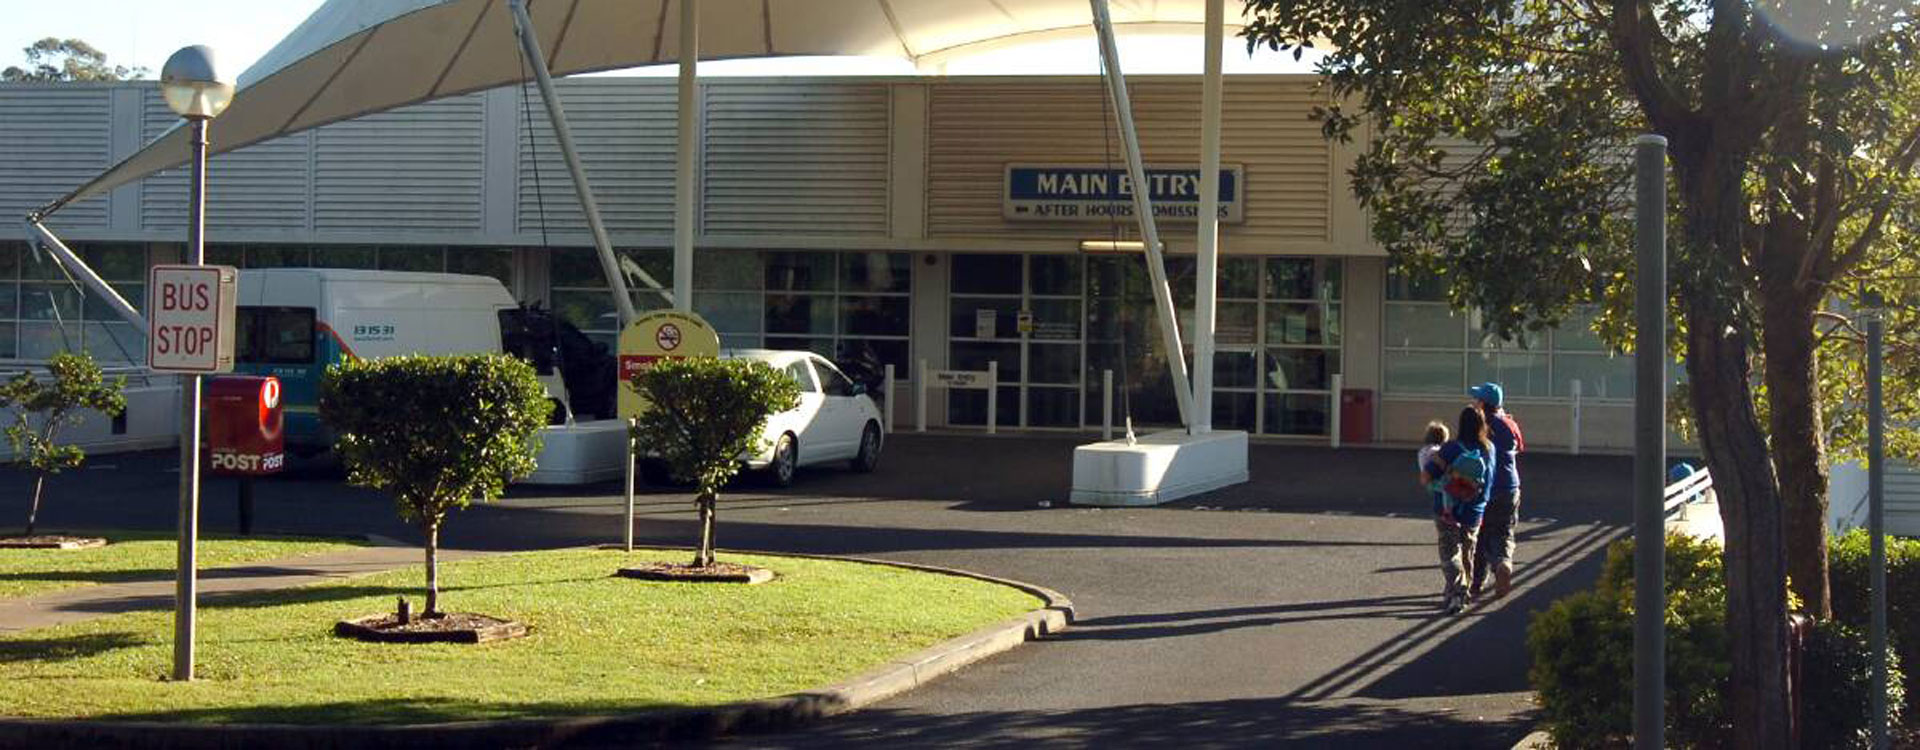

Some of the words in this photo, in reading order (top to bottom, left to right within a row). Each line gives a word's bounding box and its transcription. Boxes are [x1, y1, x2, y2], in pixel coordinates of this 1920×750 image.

[1038, 173, 1107, 195] MAIN
[1118, 173, 1202, 196] ETRY
[1034, 204, 1078, 216] AFTER
[1086, 204, 1134, 217] HOURS
[163, 283, 209, 311] BUS
[157, 325, 213, 355] STOP
[211, 454, 260, 471] POST
[263, 454, 284, 471] POST
